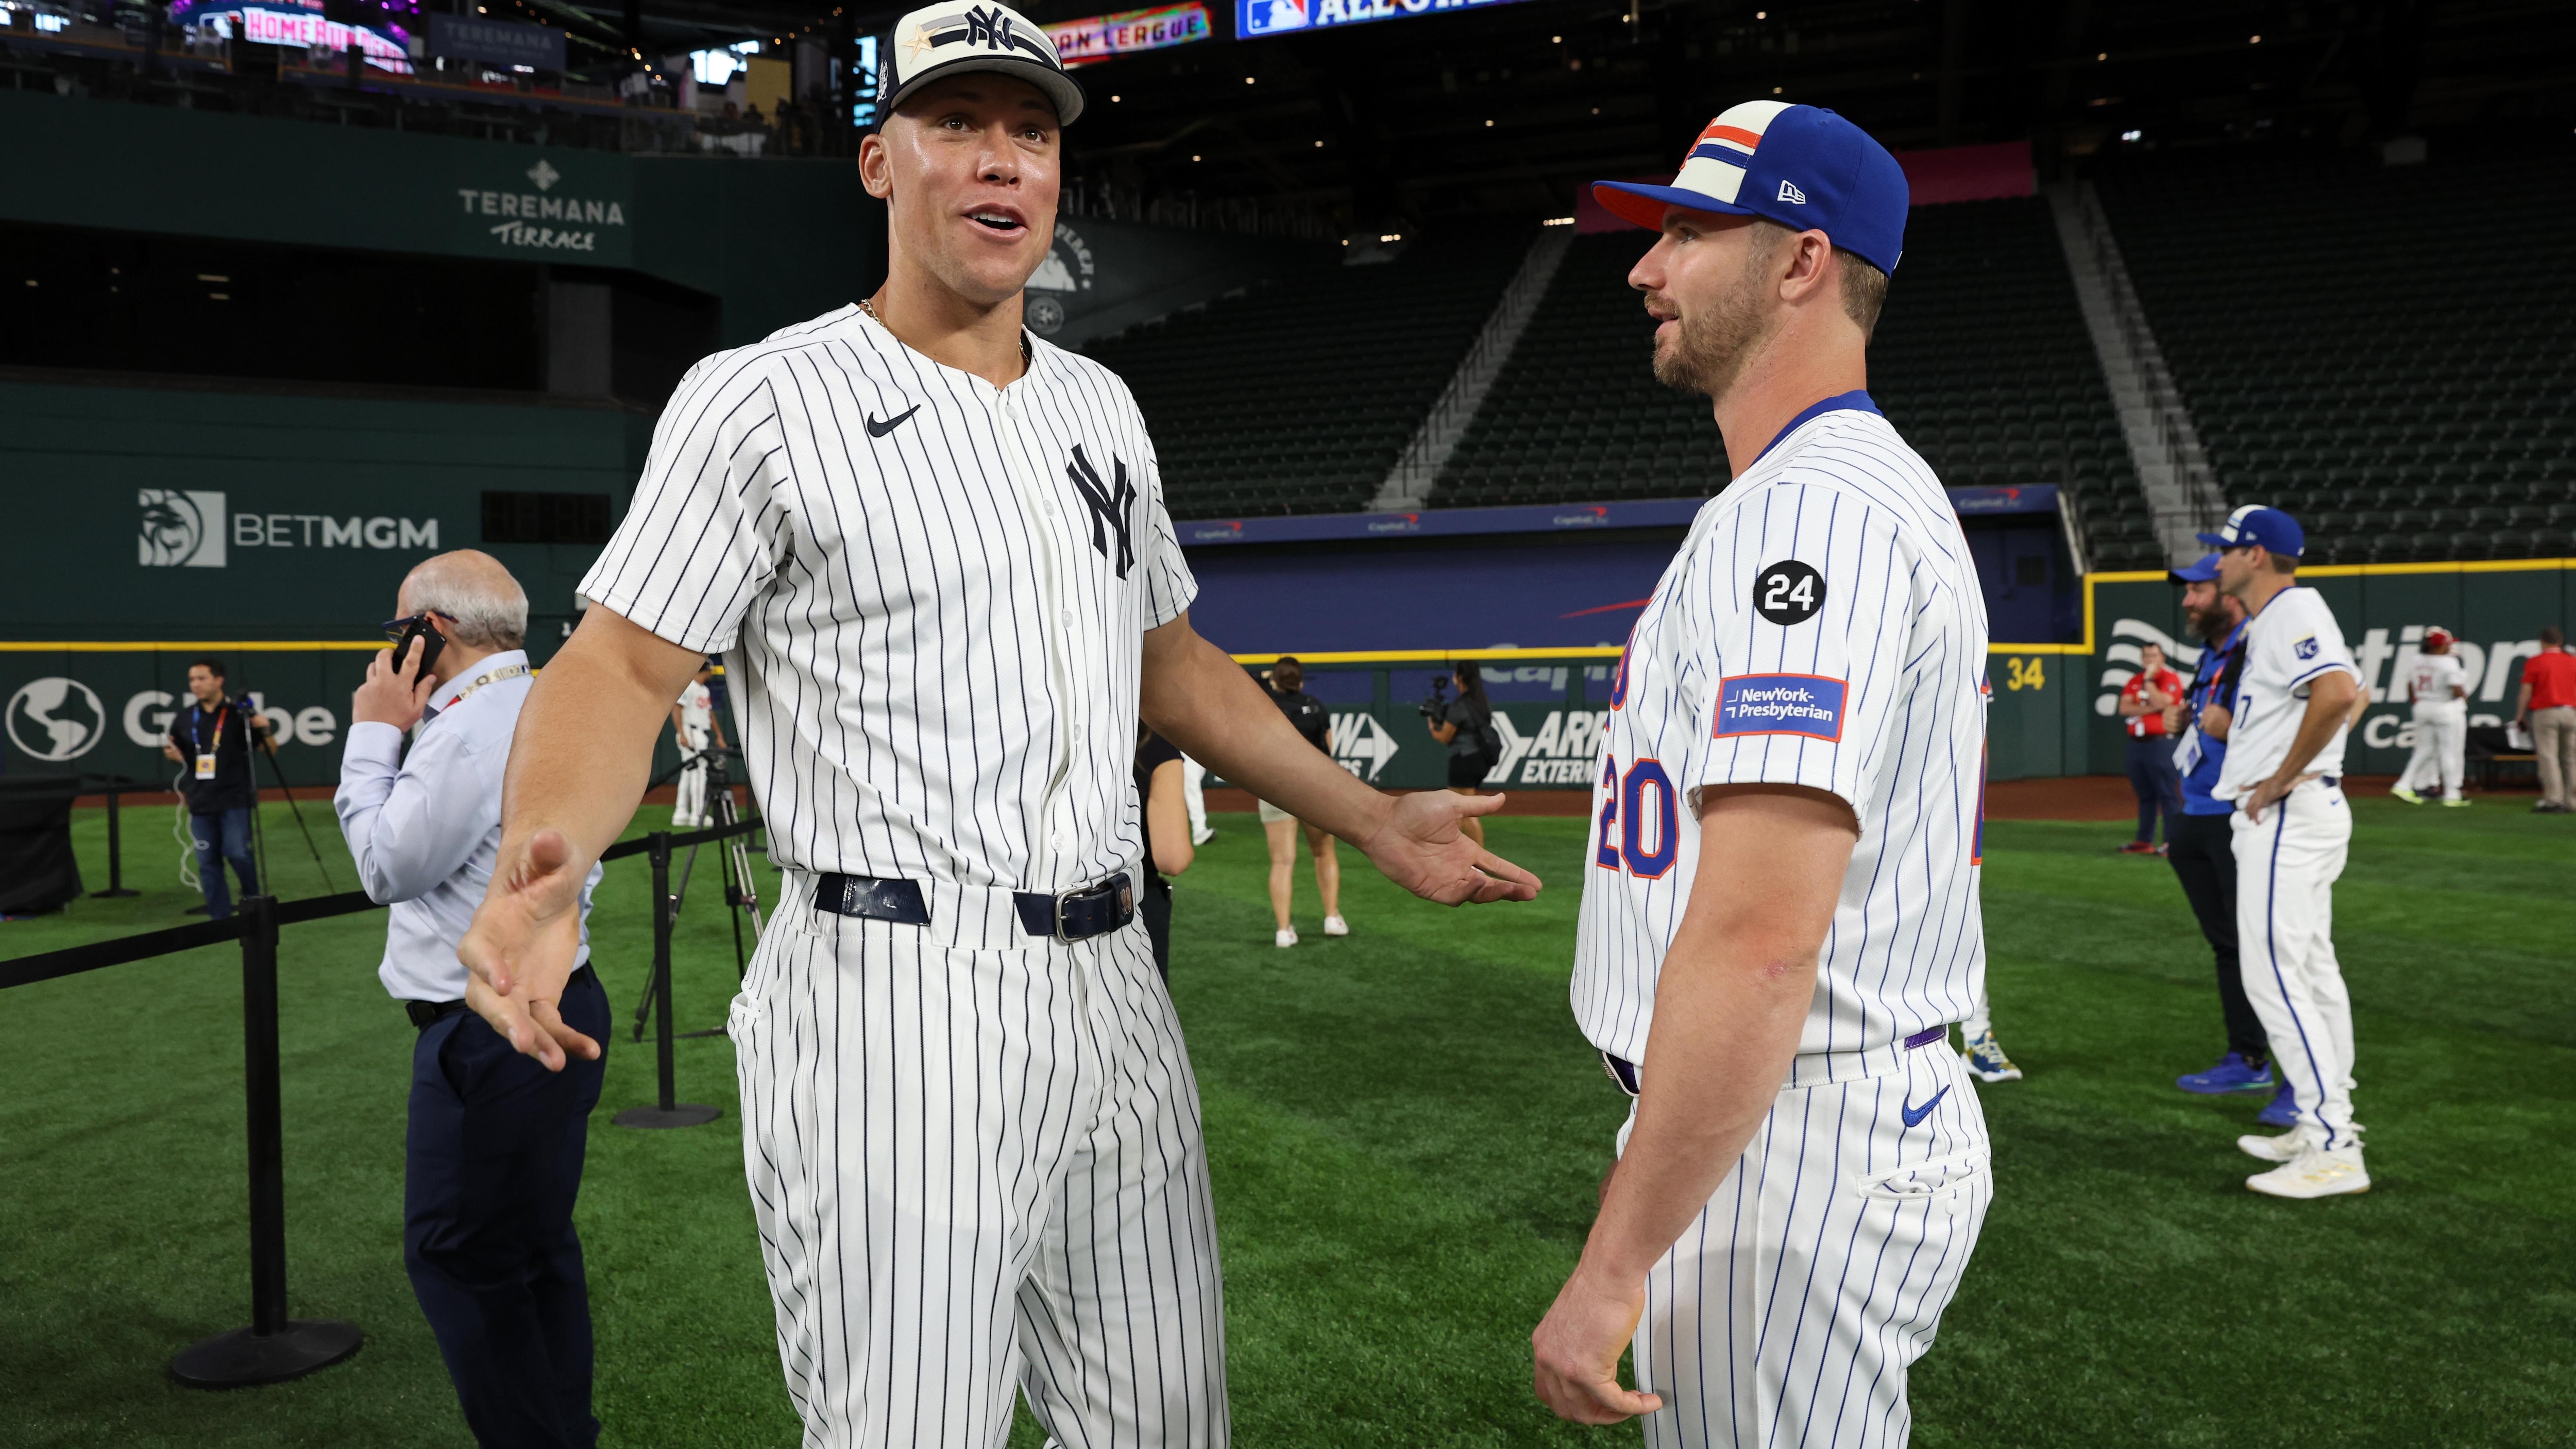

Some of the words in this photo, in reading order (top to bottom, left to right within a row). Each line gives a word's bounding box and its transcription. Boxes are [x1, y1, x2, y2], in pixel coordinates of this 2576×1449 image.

[248, 12, 308, 44] HOME
[964, 4, 1015, 52] NY
[1104, 15, 1198, 46] LEAGUE
[458, 189, 625, 226] TEREMANA
[1066, 443, 1137, 581] NY
[233, 513, 438, 550] BETMGM
[1764, 574, 1814, 611] 24
[2296, 640, 2319, 658] KC
[2007, 657, 2045, 691] 34
[1739, 703, 1833, 722] Presbyterian
[1741, 687, 1814, 703] NewYork-
[123, 690, 337, 748] Gbe
[1597, 753, 1680, 880] 20
